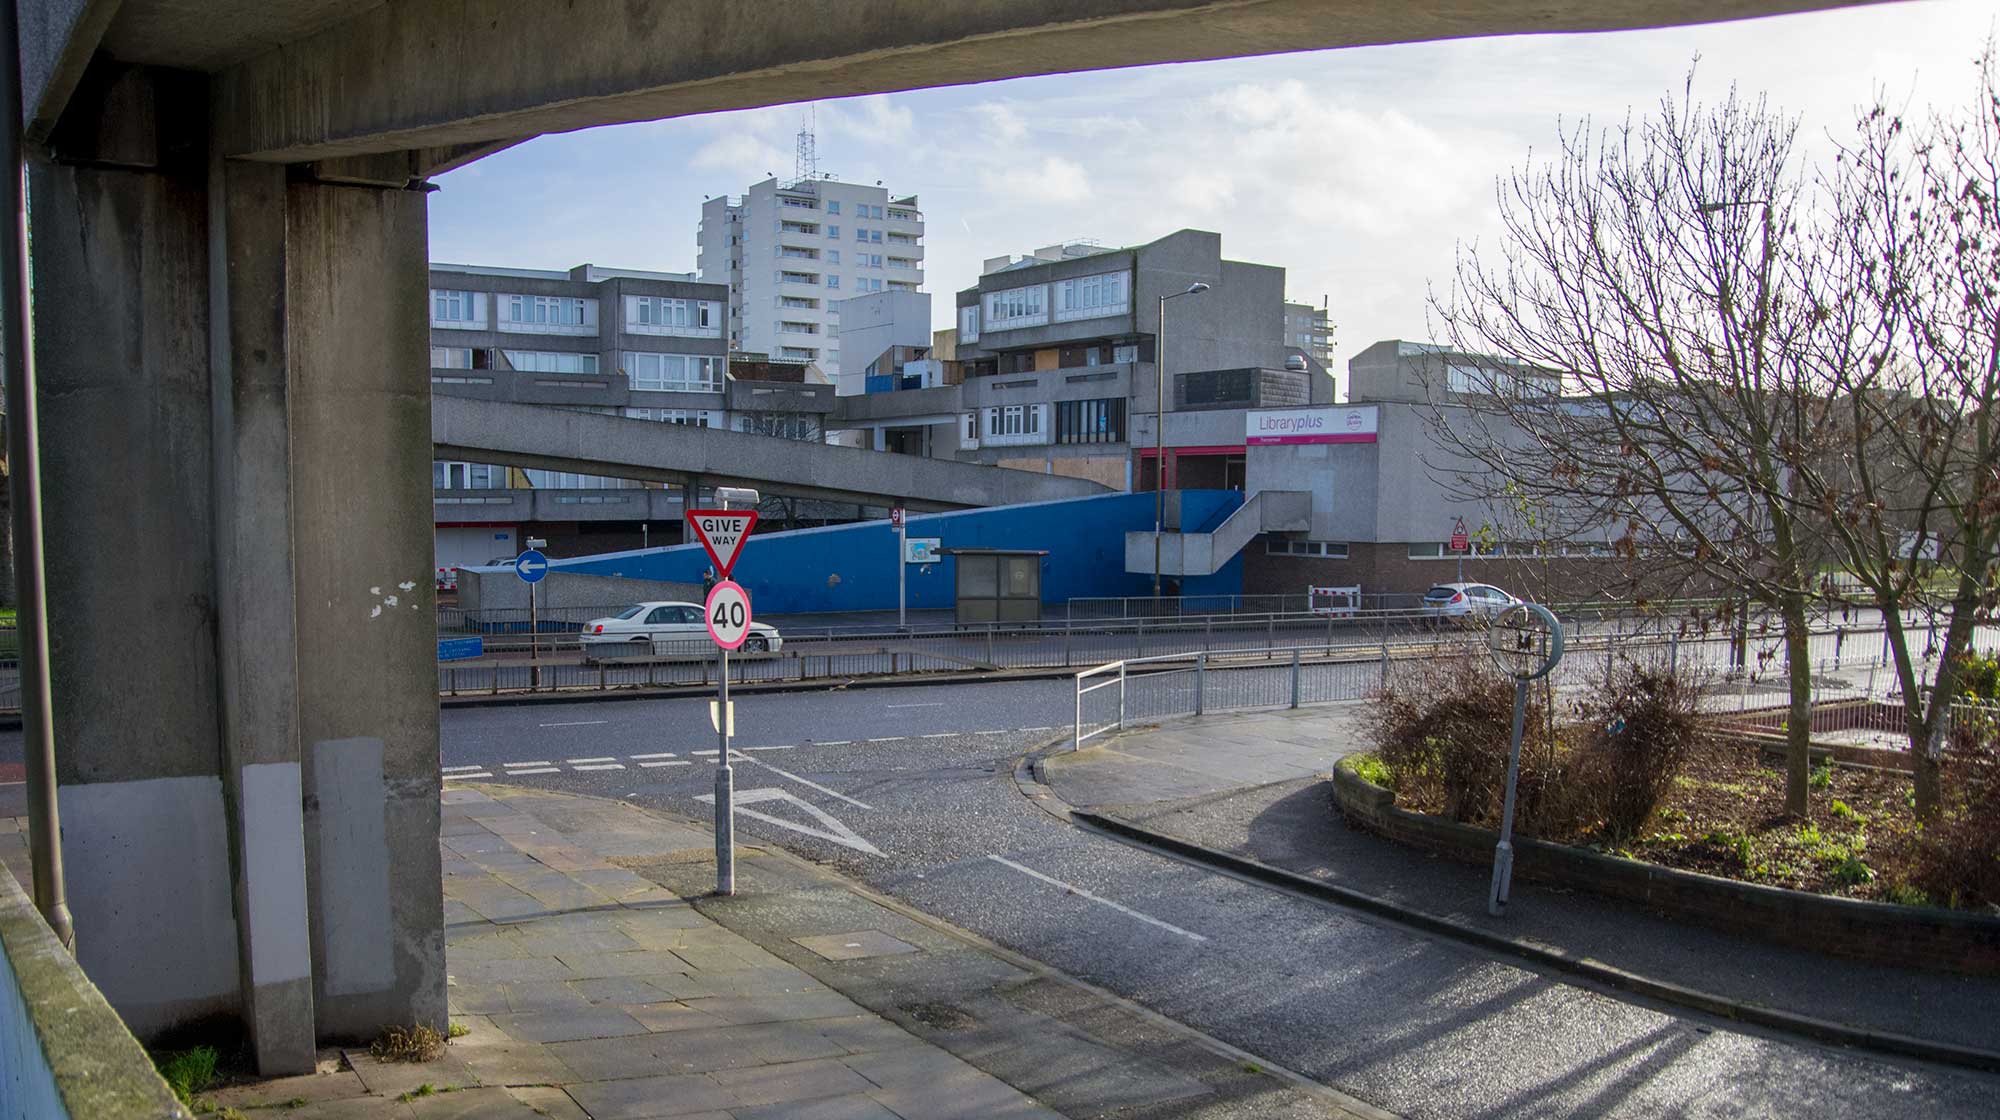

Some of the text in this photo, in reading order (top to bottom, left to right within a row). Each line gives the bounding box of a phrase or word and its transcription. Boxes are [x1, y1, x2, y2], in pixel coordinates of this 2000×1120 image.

[1260, 415, 1324, 432] Libraryplus
[702, 519, 742, 532] GIVE
[712, 536, 737, 545] WAY
[712, 601, 745, 629] 40
